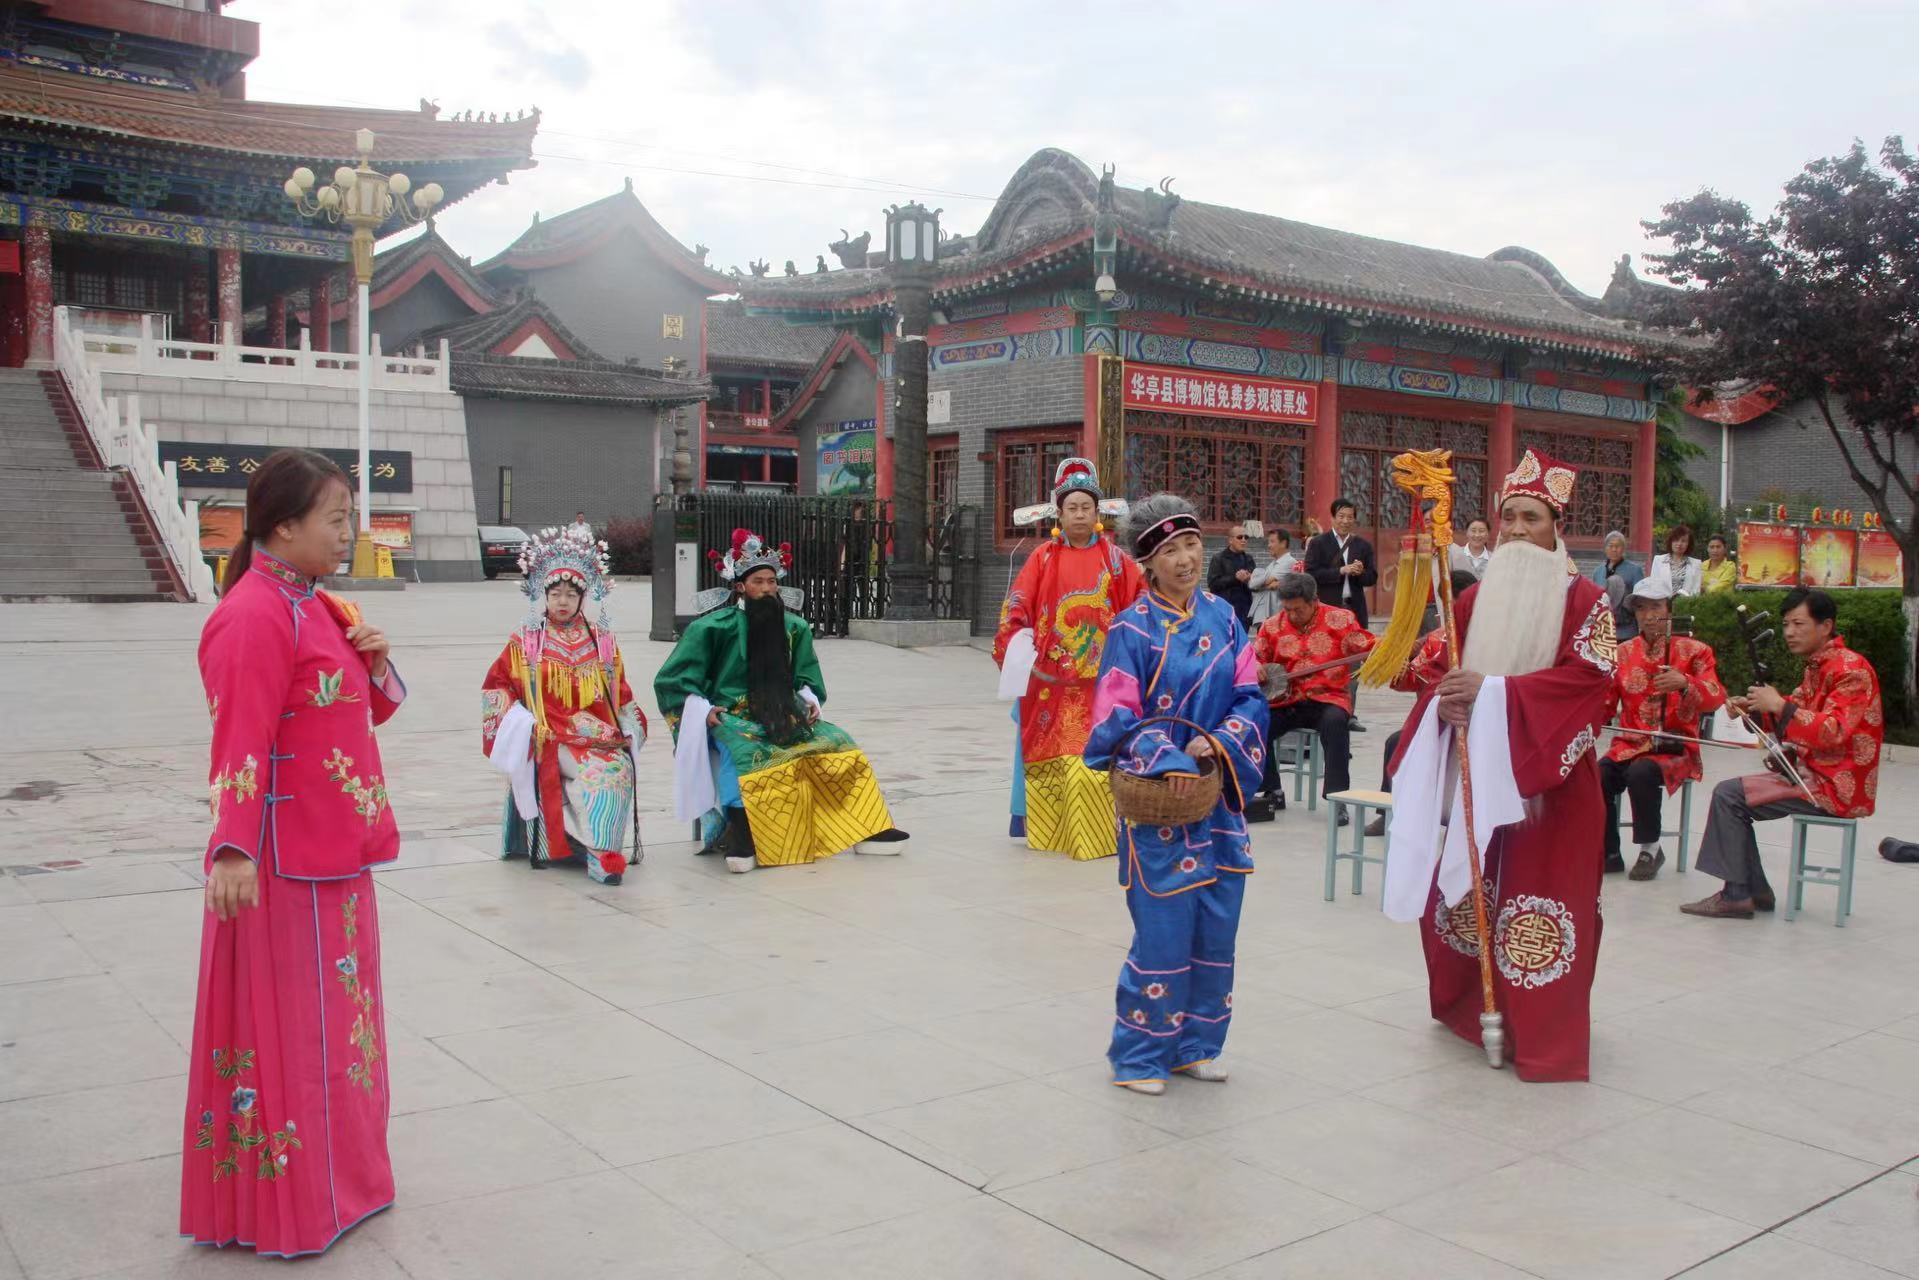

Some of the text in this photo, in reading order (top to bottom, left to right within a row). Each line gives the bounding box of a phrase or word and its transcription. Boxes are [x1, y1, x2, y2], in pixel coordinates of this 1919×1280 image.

[1131, 372, 1308, 416] 华亭县博物馆免费参观领票处
